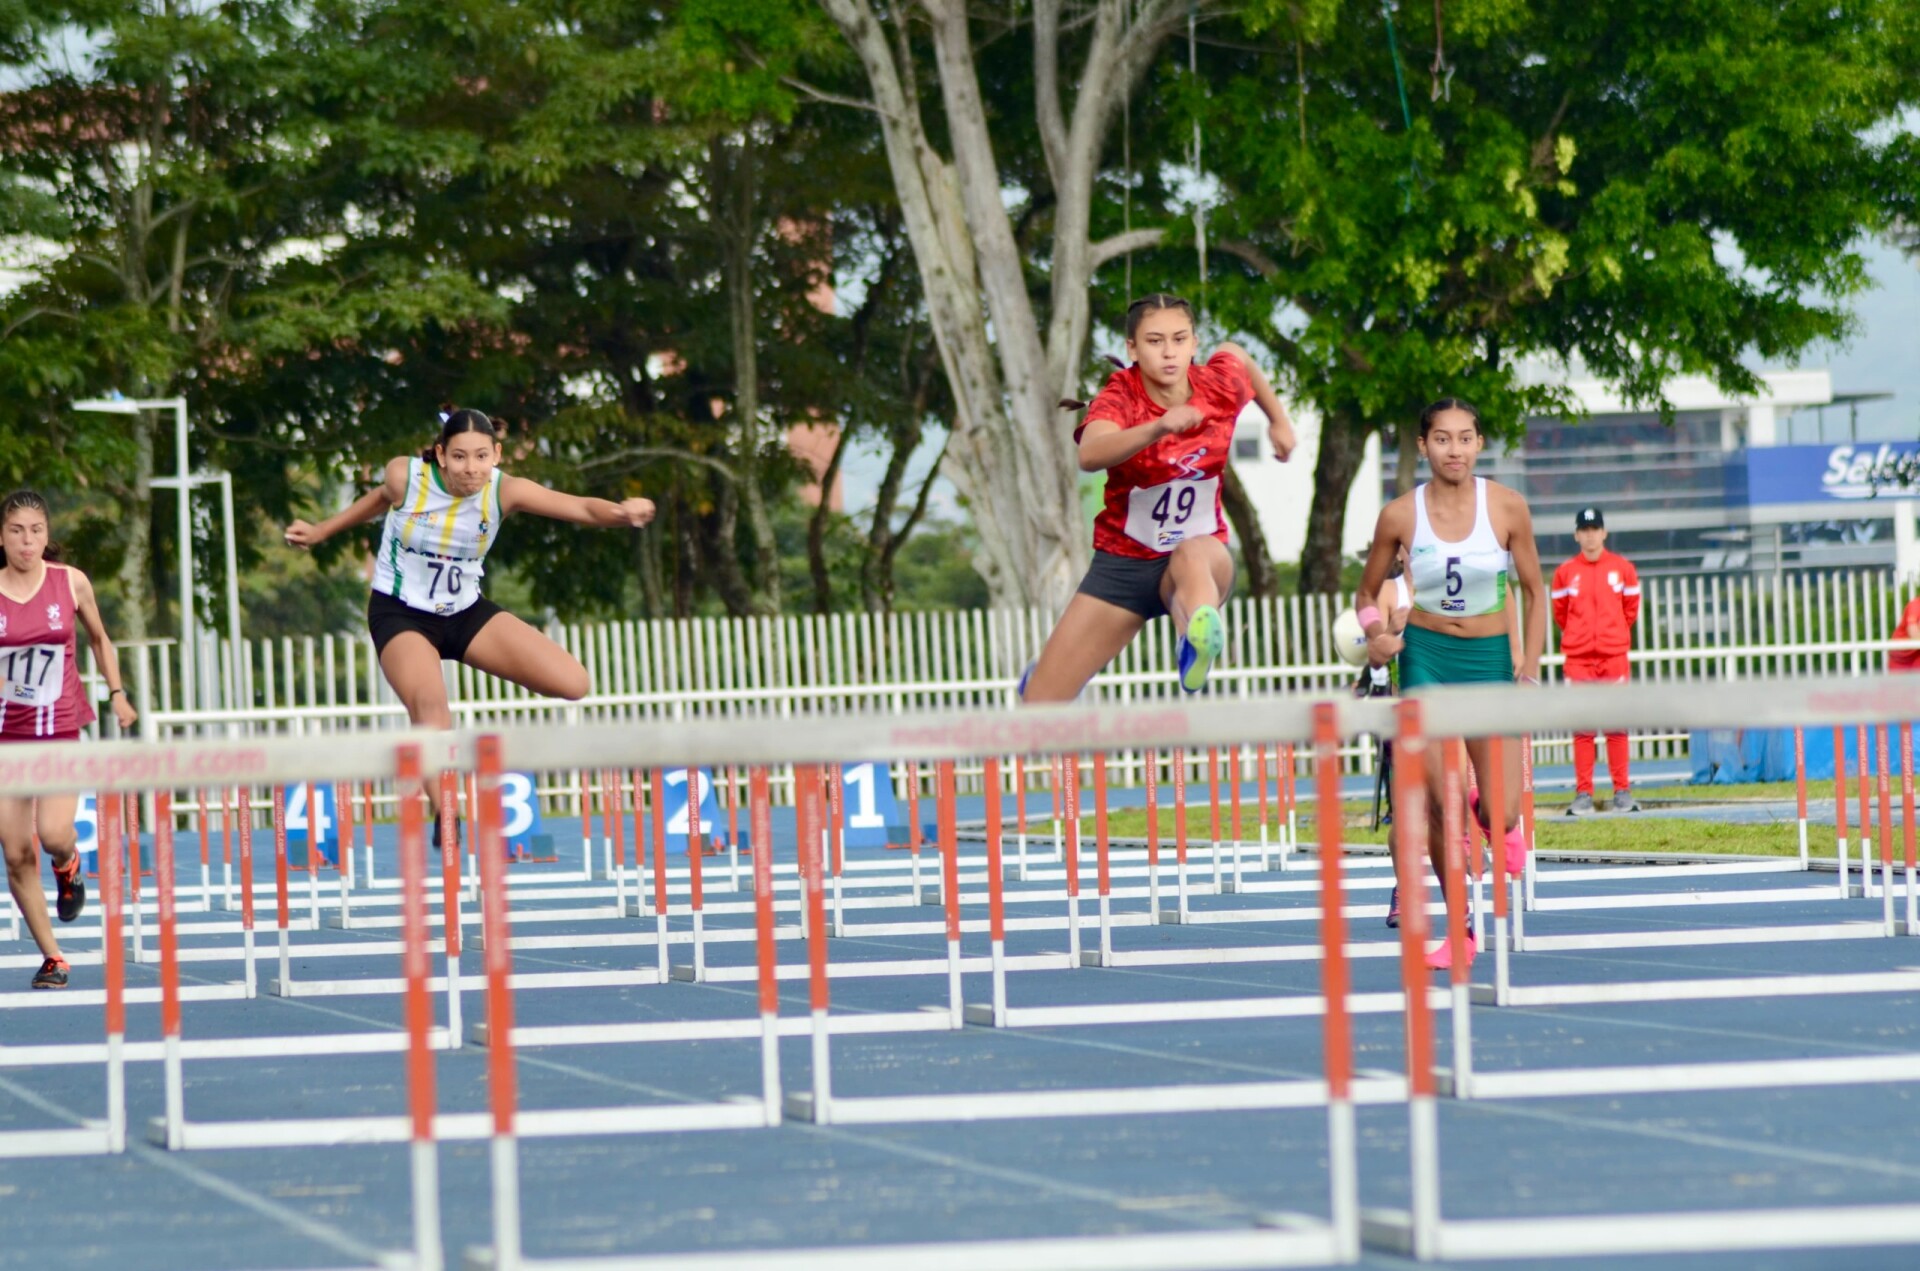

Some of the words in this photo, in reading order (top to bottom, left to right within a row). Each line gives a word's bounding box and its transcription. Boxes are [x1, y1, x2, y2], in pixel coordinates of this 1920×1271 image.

[1152, 486, 1196, 528] 49
[427, 562, 464, 599] 70
[1446, 557, 1463, 597] 5
[8, 648, 55, 686] 117
[1064, 757, 1074, 820] nordicsport.com
[1878, 730, 1889, 792] nordicsport.com
[1903, 731, 1914, 794] nordicsport.com
[240, 795, 250, 857] nordicsport.com
[275, 792, 285, 855] nordicsport.com
[286, 783, 331, 843] 4
[500, 773, 533, 837] 3
[664, 769, 713, 834] 2
[689, 774, 699, 837] nordicsport.com
[843, 763, 884, 828] 1
[443, 789, 454, 867] nordicsport.com
